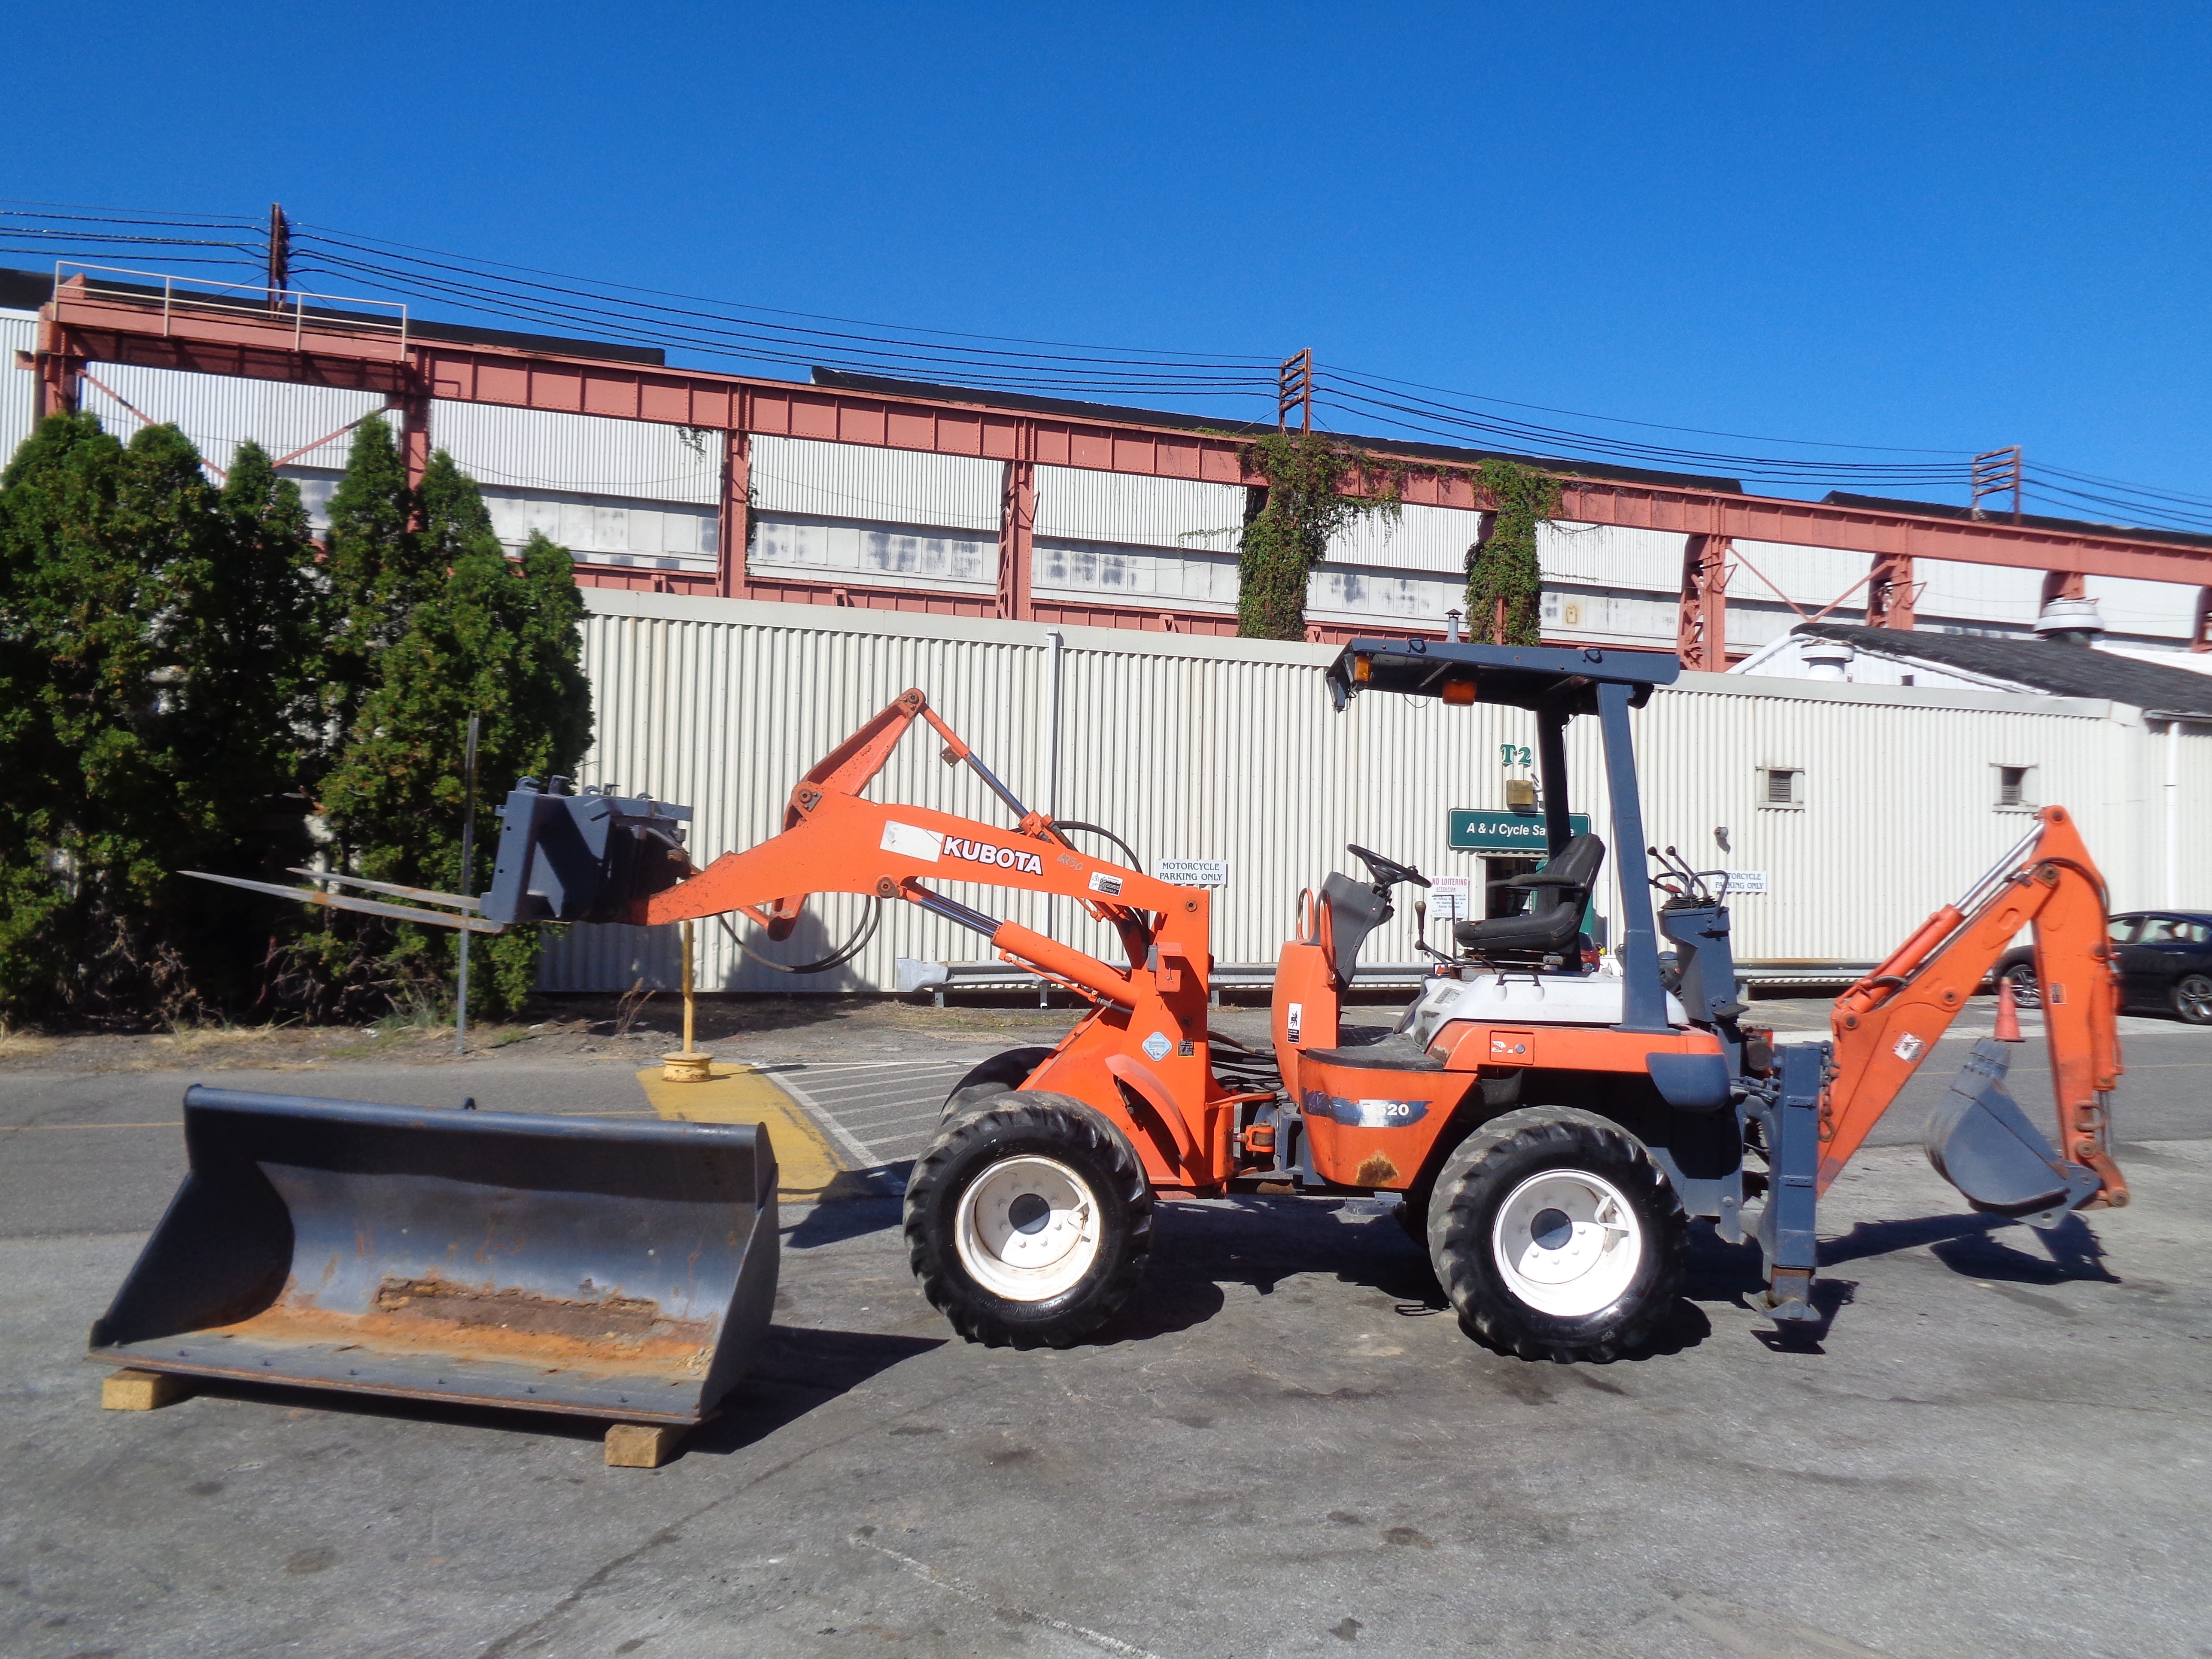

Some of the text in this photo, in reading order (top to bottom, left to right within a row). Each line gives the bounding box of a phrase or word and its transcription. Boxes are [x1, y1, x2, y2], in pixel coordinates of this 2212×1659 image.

[1466, 823, 1475, 833] A
[1478, 823, 1486, 833] &
[1489, 823, 1496, 834] J
[1499, 823, 1529, 837] Cycle
[942, 835, 1043, 876] KUBOTA
[1162, 862, 1220, 871] MOTORCYCLE
[1160, 872, 1197, 881] PARKING
